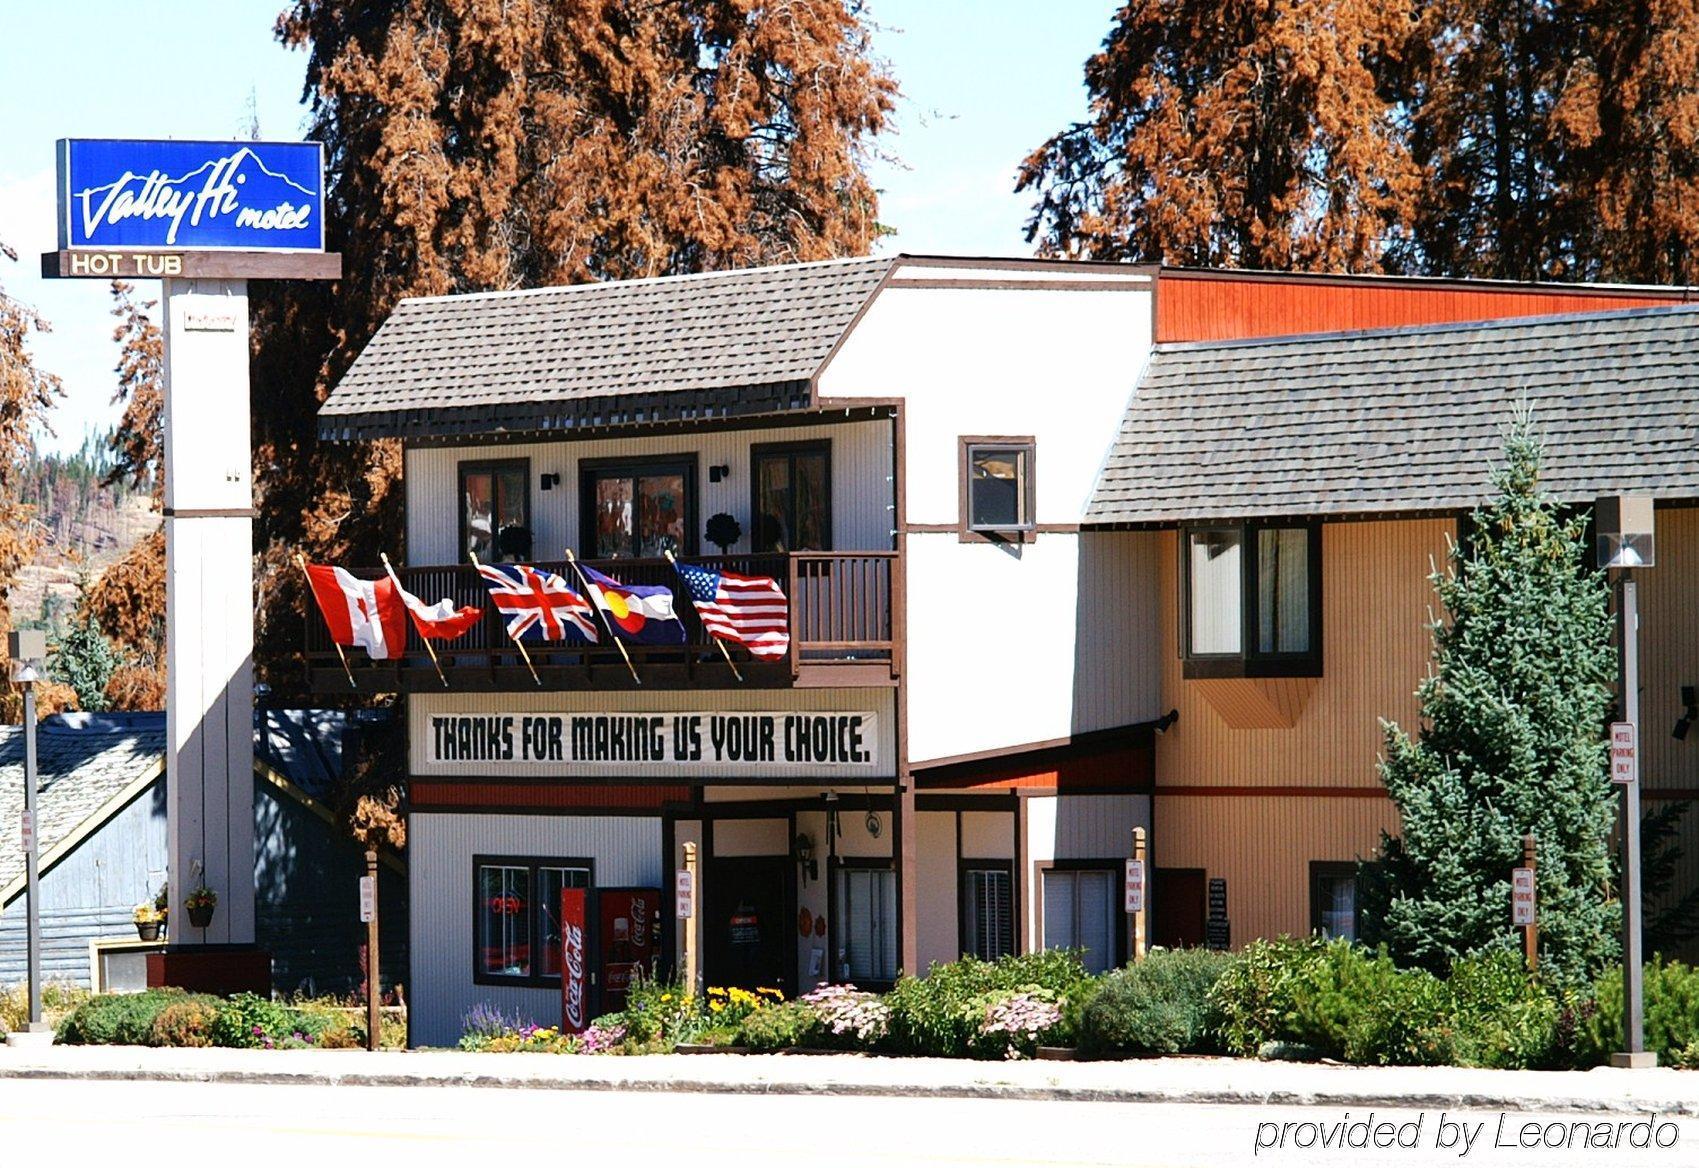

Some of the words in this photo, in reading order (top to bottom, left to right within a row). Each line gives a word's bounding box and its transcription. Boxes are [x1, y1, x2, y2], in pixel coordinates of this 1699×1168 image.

[82, 169, 194, 245] Valley
[190, 147, 247, 226] Hi
[235, 202, 312, 230] motel
[71, 254, 123, 275] HOT
[133, 254, 182, 275] TUB
[432, 716, 514, 760] THANKS
[522, 716, 563, 761] FOR
[571, 716, 664, 761] MAKING
[673, 716, 702, 762] US
[711, 716, 775, 762] YOUR
[784, 716, 871, 763] CHOICE.
[1615, 732, 1631, 743] MOTEL
[1612, 748, 1635, 758] PARKING
[1616, 763, 1630, 774] ONLY
